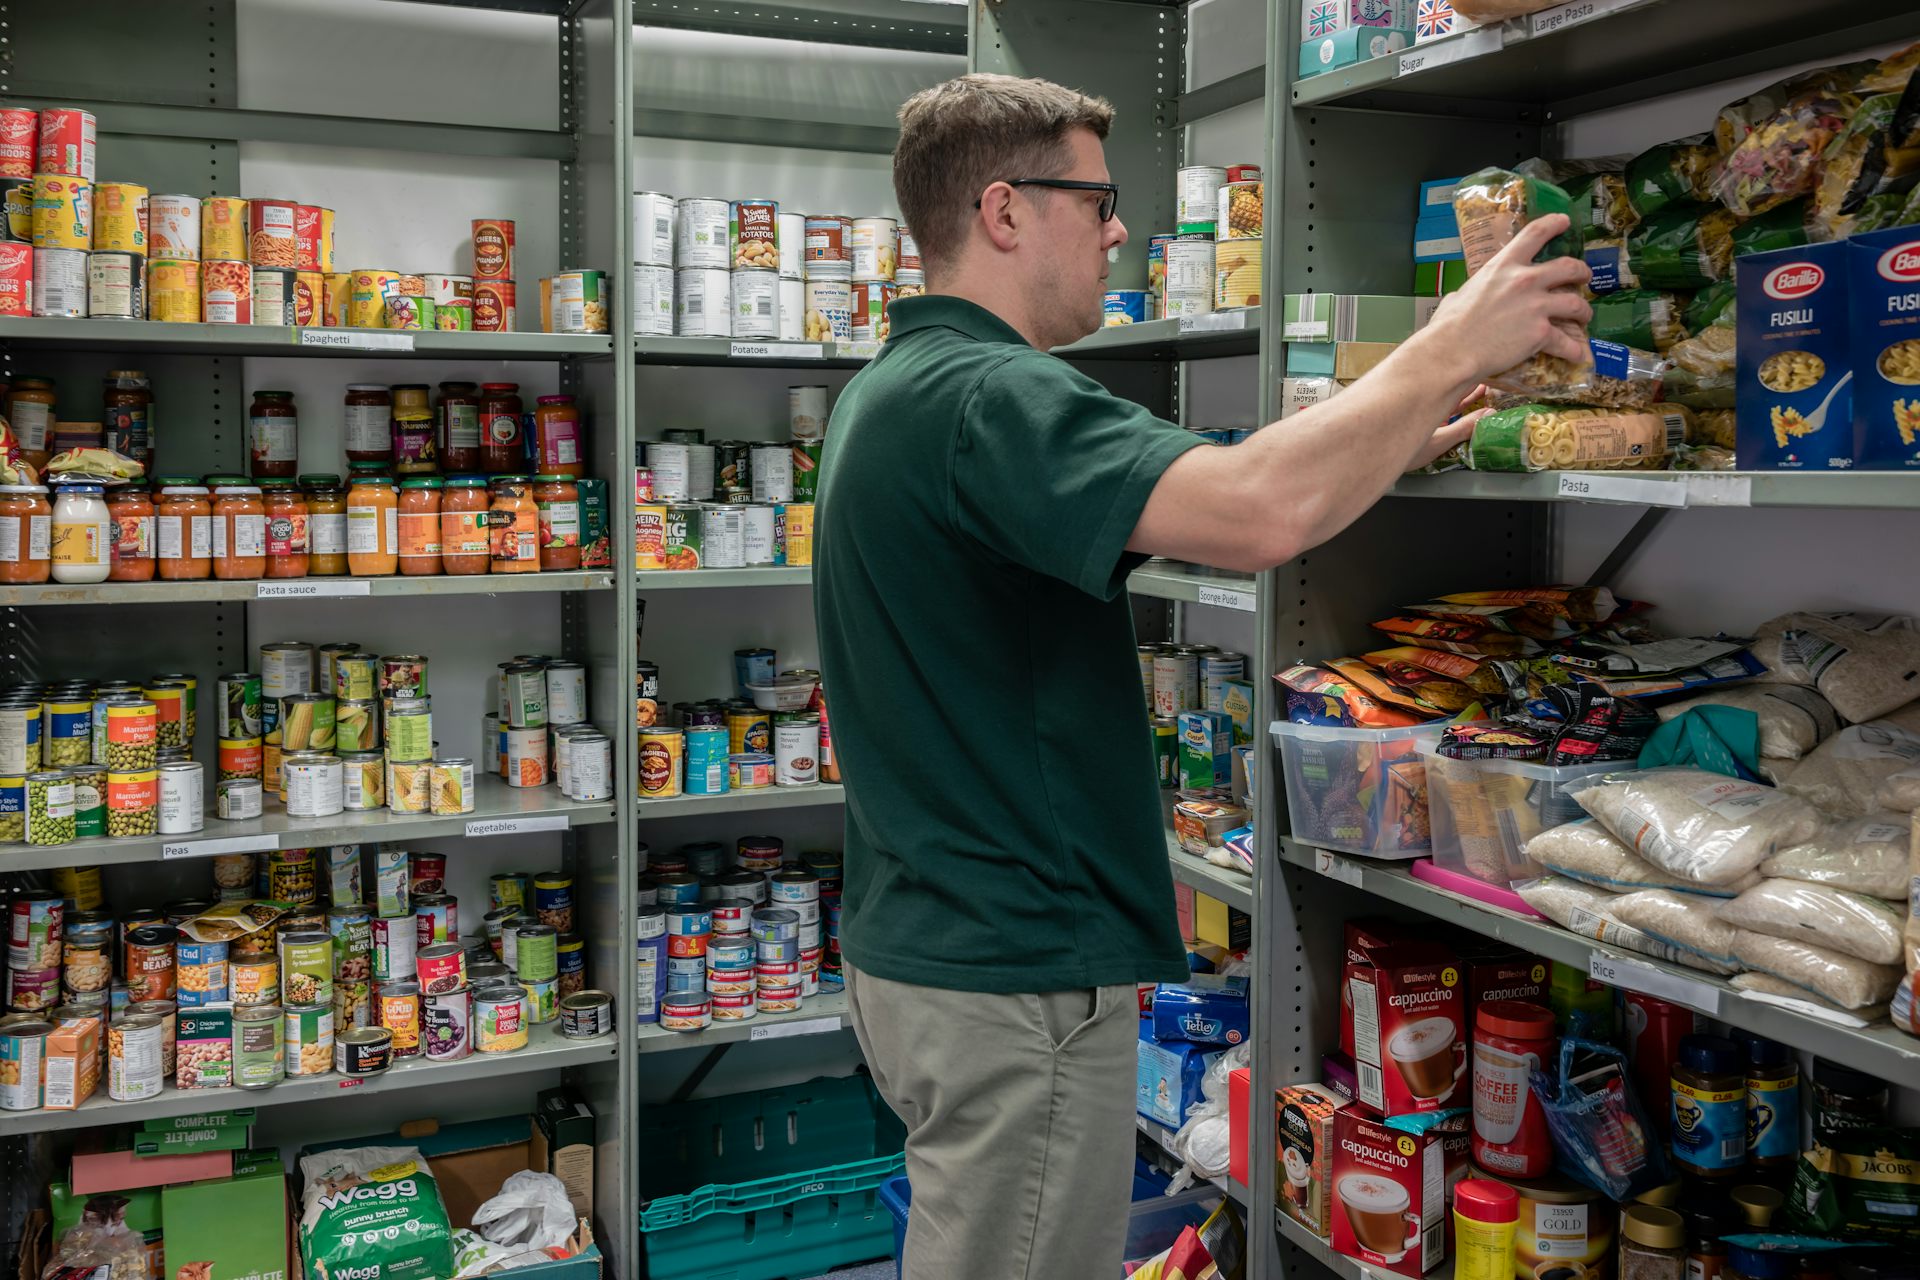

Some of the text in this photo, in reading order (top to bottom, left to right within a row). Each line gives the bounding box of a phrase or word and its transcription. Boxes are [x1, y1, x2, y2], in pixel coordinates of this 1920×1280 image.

[1535, 4, 1593, 32] Large Pasta
[1401, 57, 1424, 72] Sugar
[0, 150, 31, 159] HOOPS
[3, 202, 32, 215] SPAG
[152, 205, 179, 215] paghetti
[744, 214, 770, 225] Harvest
[476, 256, 503, 264] ravioli
[1777, 270, 1818, 290] Barilla
[1888, 294, 1920, 312] FUSI
[475, 317, 499, 325] ravioli
[1770, 309, 1813, 326] FUSILLI
[1180, 320, 1194, 329] Fruit
[304, 333, 350, 345] Spaghetti
[732, 346, 768, 354] Potatoes
[1562, 479, 1589, 494] Pasta
[731, 494, 750, 503] HEIN
[666, 522, 686, 536] IG
[260, 586, 285, 595] Pasta
[1200, 590, 1237, 605] Sponge Pudd
[1226, 702, 1248, 712] CUSTARD
[1187, 732, 1205, 741] Custard
[115, 792, 150, 800] Marrowfat
[467, 822, 517, 834] Vegetables
[165, 846, 188, 856] Peas
[350, 944, 369, 952] BEAN
[690, 939, 696, 948] 4
[183, 948, 198, 958] End
[143, 958, 172, 970] BEANS
[560, 964, 584, 972] Mushroom
[1592, 961, 1615, 979] Rice
[1411, 973, 1436, 982] lifestyle
[1444, 972, 1455, 982] £1
[1533, 969, 1543, 979] £1
[1389, 988, 1453, 1008] cappuccino
[1483, 983, 1540, 1001] cappuccino
[386, 1004, 413, 1013] GOOD
[181, 1022, 195, 1030] SO
[1184, 1019, 1216, 1035] Tetley
[1336, 1081, 1351, 1096] TESCO
[1476, 1072, 1518, 1095] COFFEE
[1475, 1084, 1517, 1104] WHITENER
[175, 1116, 227, 1128] COMPLETE
[1287, 1121, 1303, 1137] GOLD
[1366, 1127, 1392, 1142] lifestyle
[164, 1129, 217, 1144] COMPLETE
[1165, 1138, 1174, 1149] Te
[1400, 1140, 1412, 1151] £1
[1341, 1138, 1408, 1168] cappuccino
[1862, 1162, 1912, 1176] JACOBS
[801, 1183, 824, 1194] IFCO
[318, 1180, 418, 1210] Wagg
[329, 1204, 357, 1219] Healthy
[344, 1207, 408, 1226] bunny brunch
[1544, 1219, 1581, 1231] GOLD
[405, 1257, 423, 1266] brunch
[335, 1265, 380, 1280] Wagg
